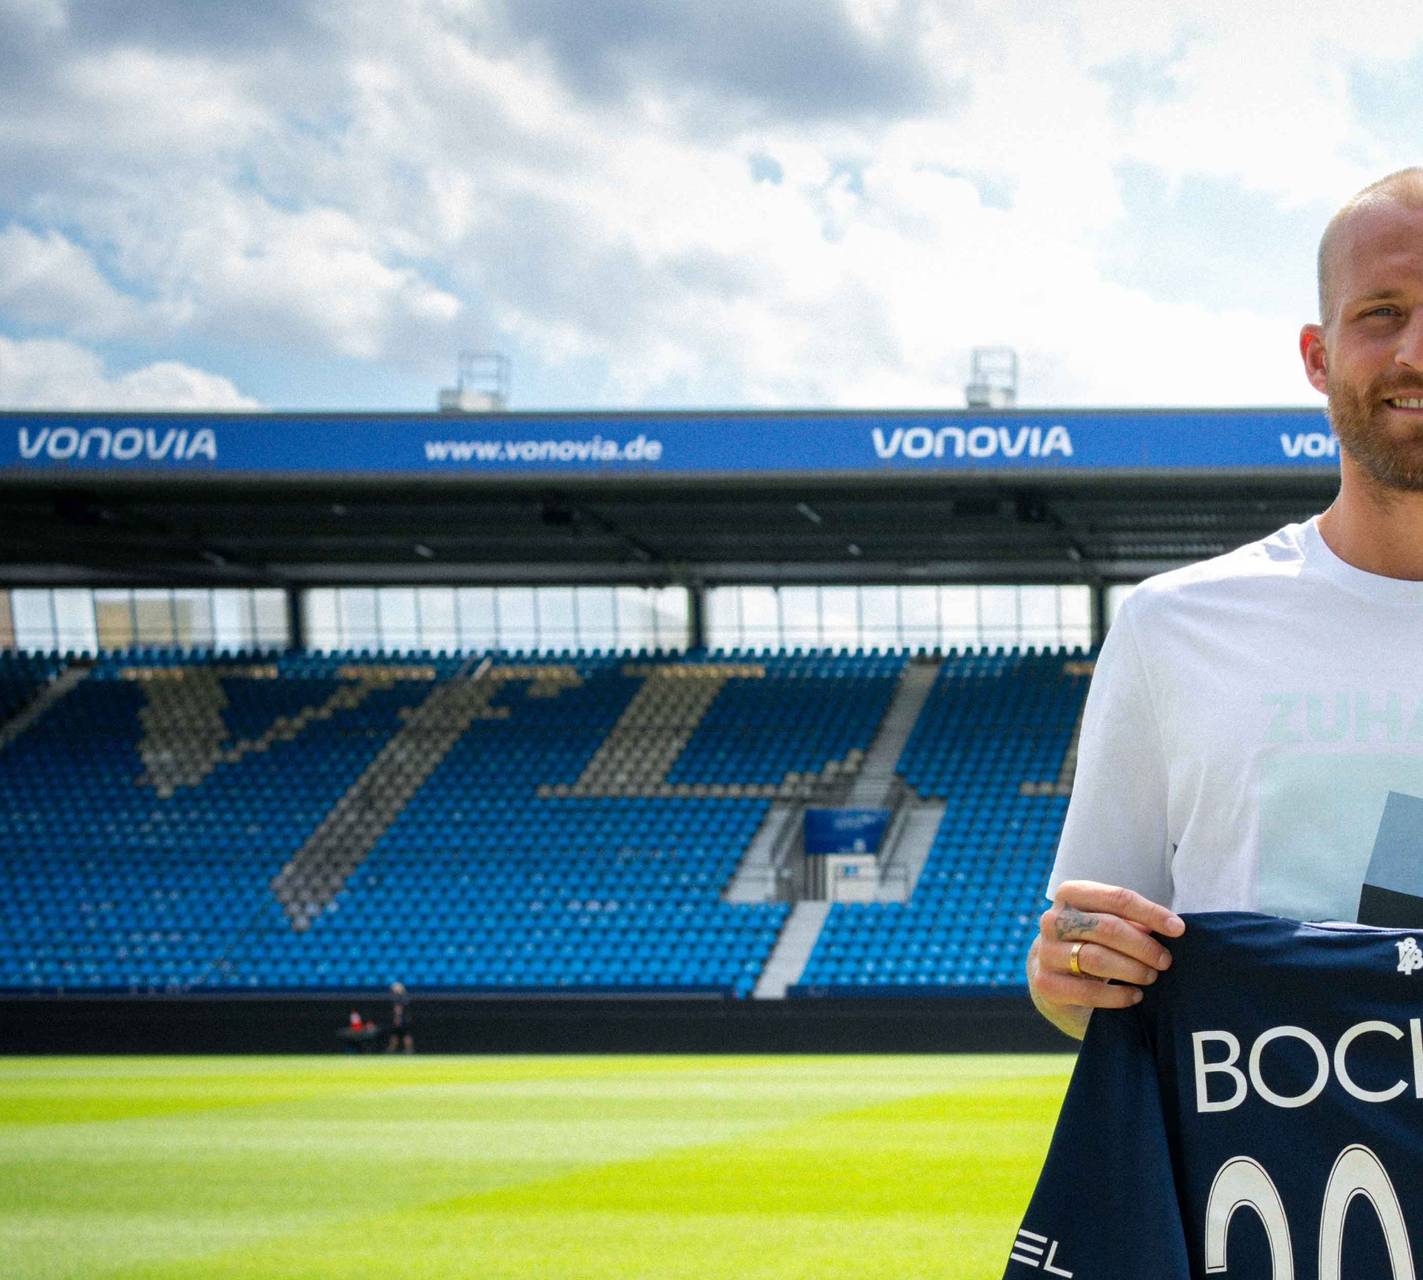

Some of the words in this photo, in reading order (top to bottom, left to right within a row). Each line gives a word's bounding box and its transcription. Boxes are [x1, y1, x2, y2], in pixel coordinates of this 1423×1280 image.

[18, 427, 218, 461] VONOVIA
[424, 435, 663, 463] www.vonovia.de
[871, 425, 1074, 459] VONOVIA
